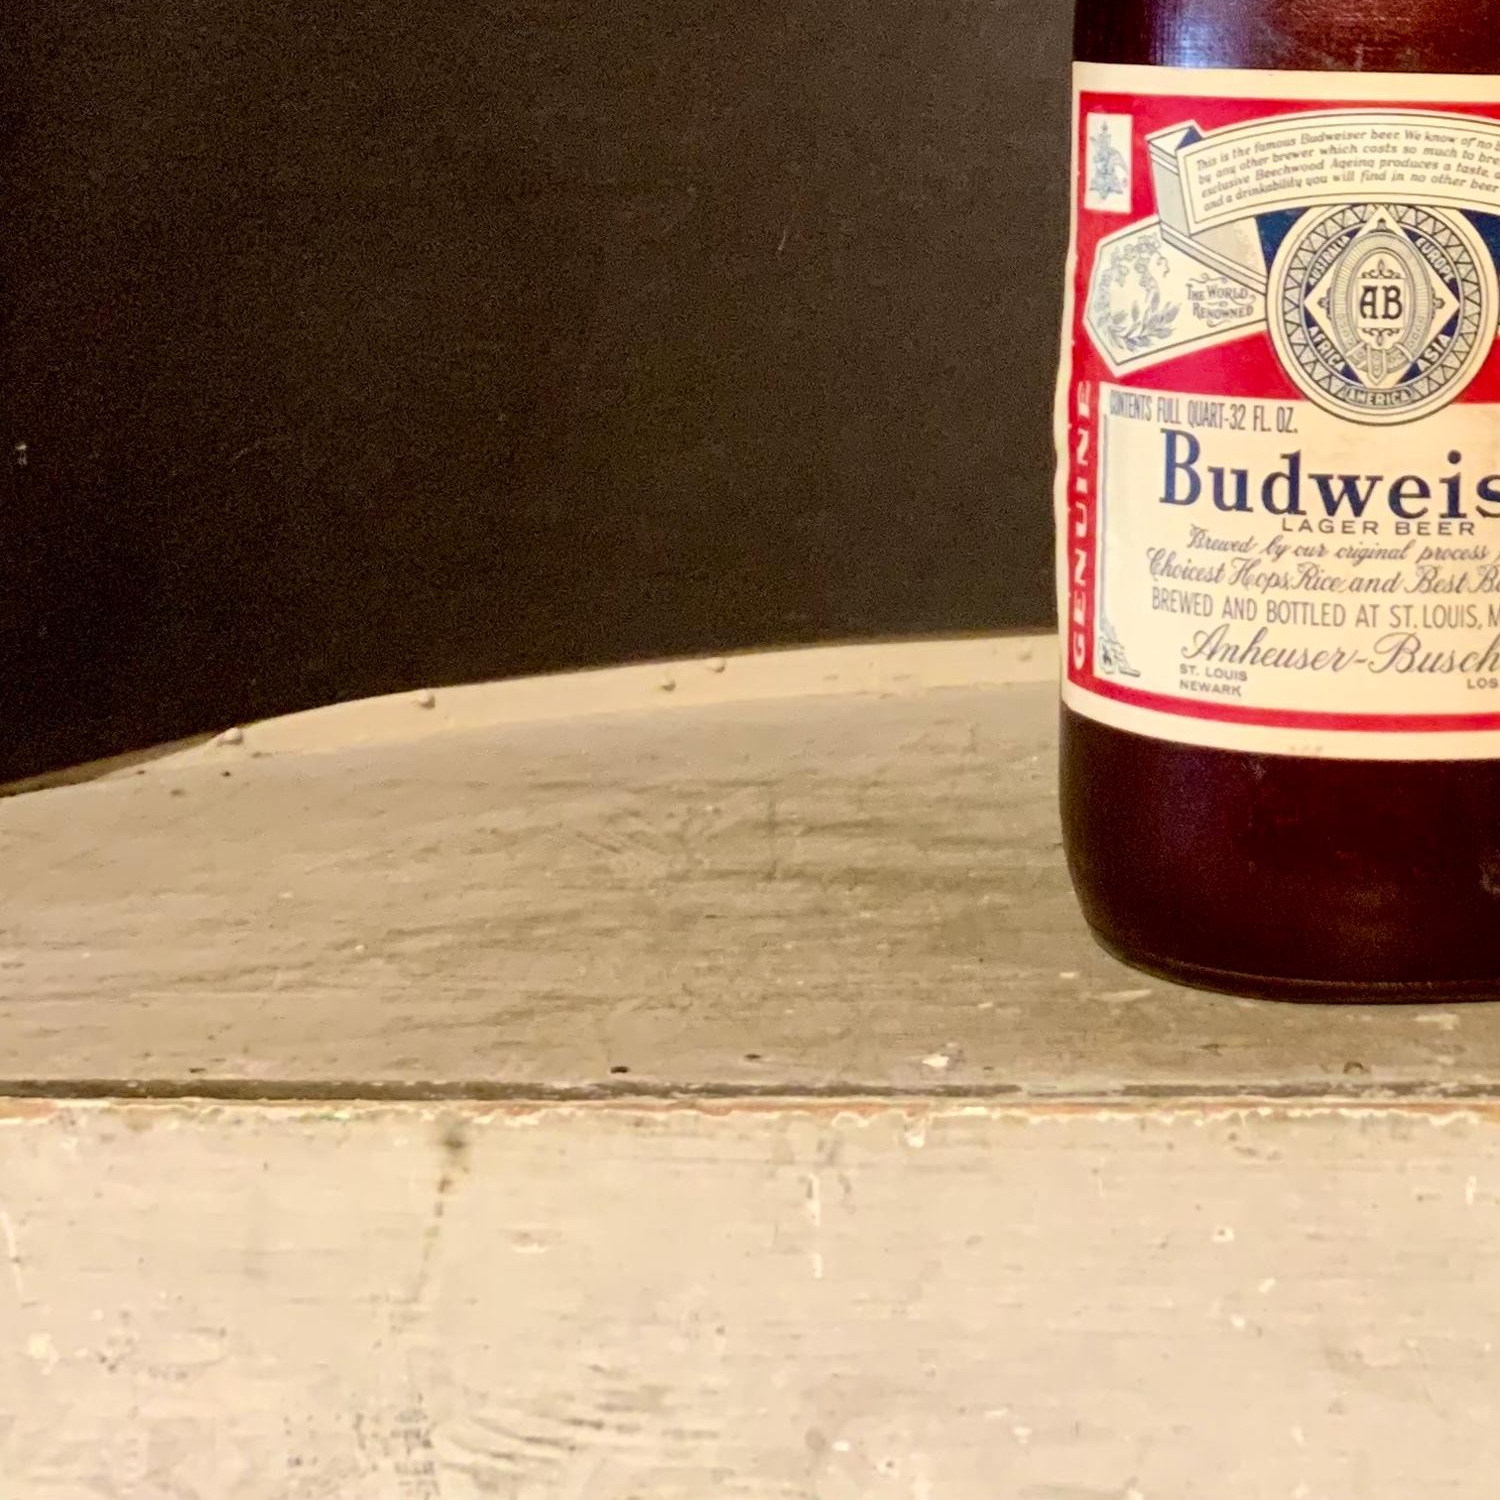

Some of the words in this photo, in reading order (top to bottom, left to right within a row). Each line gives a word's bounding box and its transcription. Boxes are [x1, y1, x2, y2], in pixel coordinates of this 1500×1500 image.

[1196, 157, 1217, 171] This
[1220, 152, 1229, 163] is
[1232, 147, 1251, 160] the
[1254, 137, 1296, 152] famous
[1300, 131, 1367, 145] Budweiser
[1404, 129, 1422, 141] We
[1424, 130, 1457, 143] know
[1460, 136, 1476, 149] of
[1477, 139, 1492, 150] no
[1239, 157, 1270, 171] other
[1272, 150, 1315, 164] brewer
[1319, 141, 1358, 155] which
[1362, 143, 1397, 153] costs
[1402, 145, 1417, 154] so
[1423, 145, 1458, 159] much
[1462, 149, 1475, 161] to
[1201, 174, 1250, 198] exclusive
[1255, 159, 1325, 181] Beechwood
[1378, 158, 1439, 170] produces
[1203, 199, 1225, 212] and
[1235, 176, 1303, 201] drinkability
[1305, 174, 1328, 187] you
[1332, 169, 1355, 182] will
[1360, 169, 1387, 183] find
[1391, 169, 1405, 182] in
[1410, 172, 1427, 182] no
[1430, 172, 1467, 187] other
[1470, 178, 1500, 193] beer
[1415, 236, 1451, 284] EUROPE
[1359, 285, 1404, 320] AB
[1307, 325, 1347, 372] AFRICA
[1417, 333, 1451, 372] ASIA
[1156, 396, 1181, 425] FULL
[1253, 404, 1272, 432] FL.
[1276, 406, 1298, 434] OZ.
[1347, 388, 1411, 406] AMERICA
[1186, 523, 1257, 553] Brewed
[1261, 534, 1289, 563] by
[1293, 542, 1328, 559] our
[1334, 538, 1416, 567] original
[1416, 544, 1488, 565] process
[1281, 517, 1379, 535] LAGER
[1395, 521, 1475, 536] BEER
[1147, 546, 1225, 585] Choicest
[1291, 561, 1347, 593] Rice
[1349, 570, 1402, 594] and
[1405, 564, 1468, 594] Best
[1151, 586, 1214, 618] BREWED
[1221, 596, 1258, 622] AND
[1266, 599, 1346, 628] BOTTLED
[1354, 603, 1380, 628] AT
[1179, 663, 1200, 676] ST.
[1205, 665, 1248, 682] LOUIS
[1179, 679, 1242, 697] NEWARK
[1466, 677, 1499, 690] LOS
